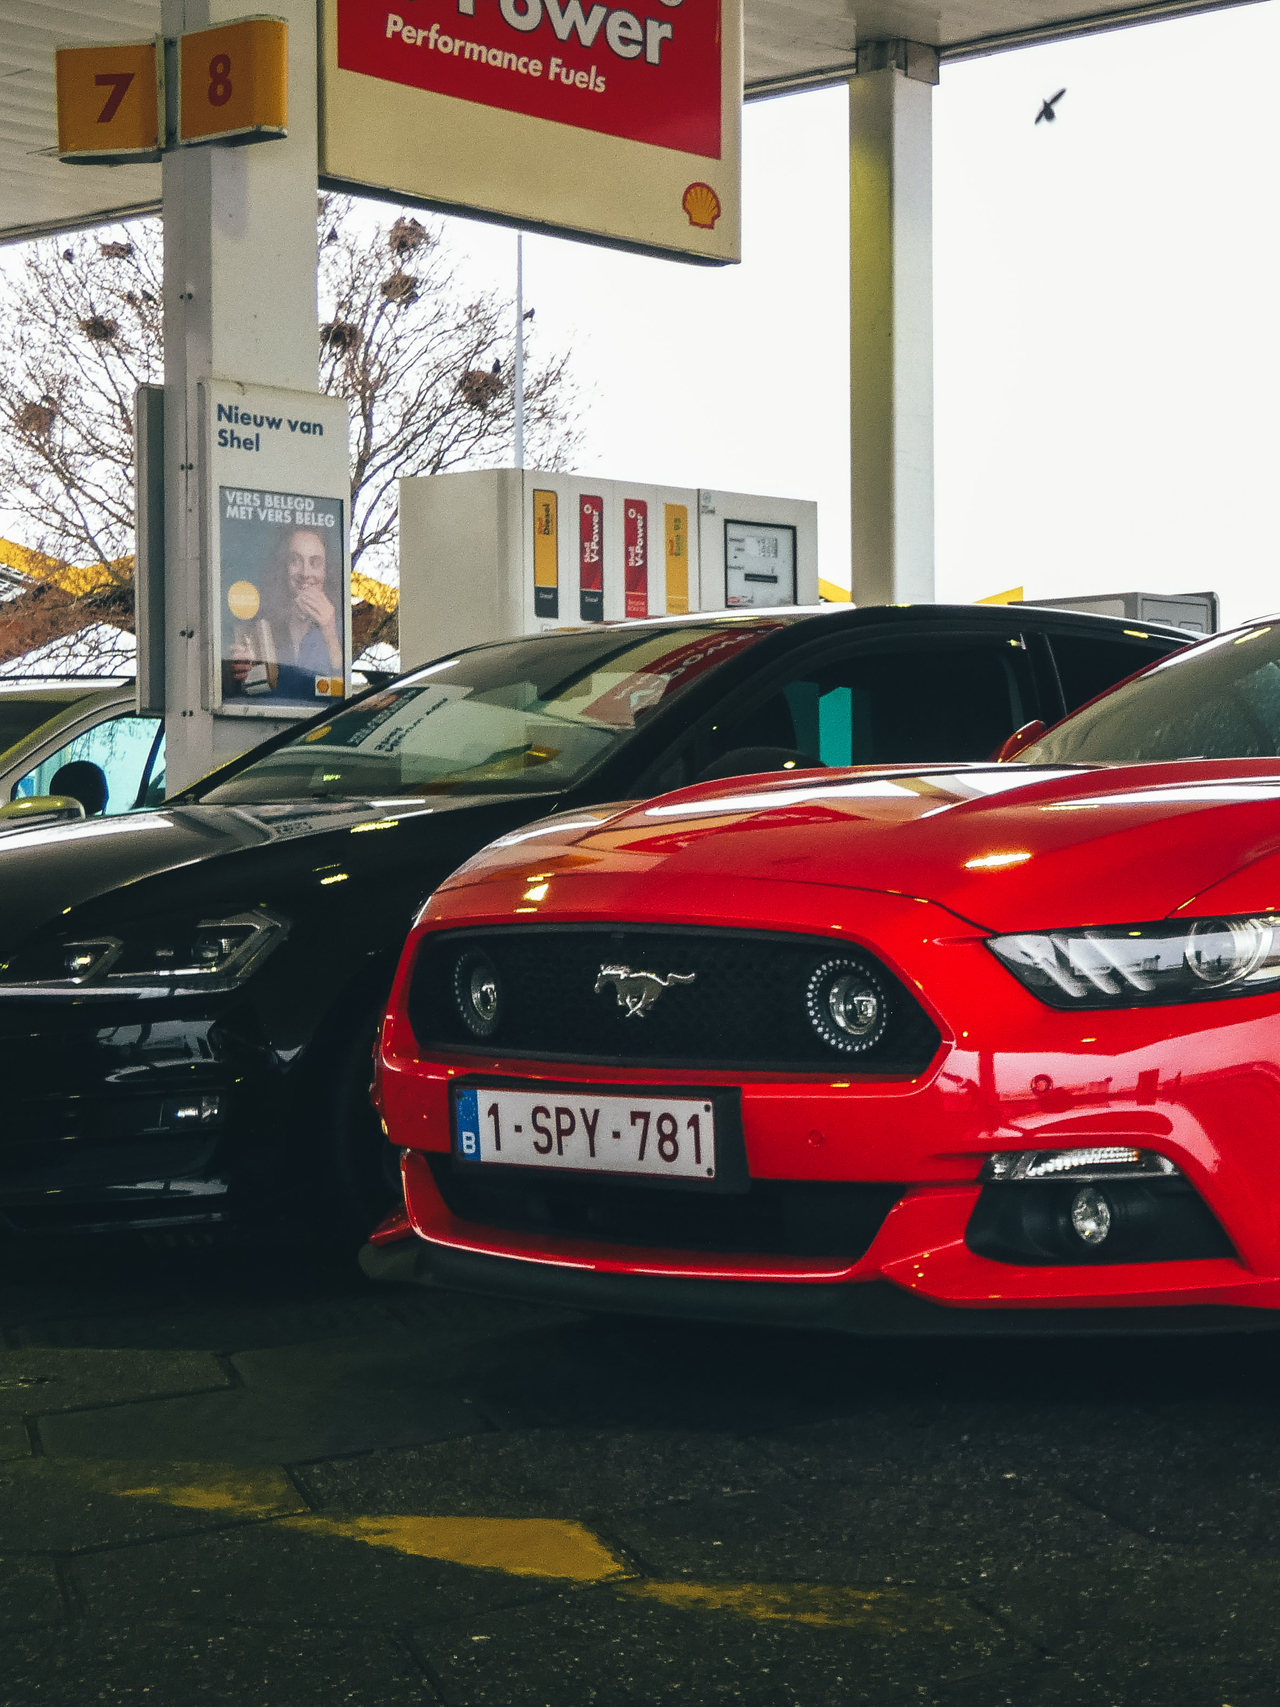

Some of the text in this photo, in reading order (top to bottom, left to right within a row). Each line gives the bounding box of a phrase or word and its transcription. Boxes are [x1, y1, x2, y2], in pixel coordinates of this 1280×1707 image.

[457, 0, 673, 66] ower
[385, 13, 606, 93] Performance Fuels
[208, 54, 232, 107] 8
[95, 73, 135, 123] 7
[217, 403, 324, 436] Nieuw van
[217, 428, 260, 452] Shel
[225, 491, 315, 512] VERS BELEGD
[226, 505, 335, 528] MET VERS BELEG
[543, 503, 551, 536] Diesel
[590, 508, 600, 563] V-Power
[583, 541, 591, 563] Shell
[628, 545, 636, 567] Shell
[635, 512, 645, 567] V-Power
[462, 1131, 476, 1154] B
[487, 1102, 702, 1165] 1-SPY-781
